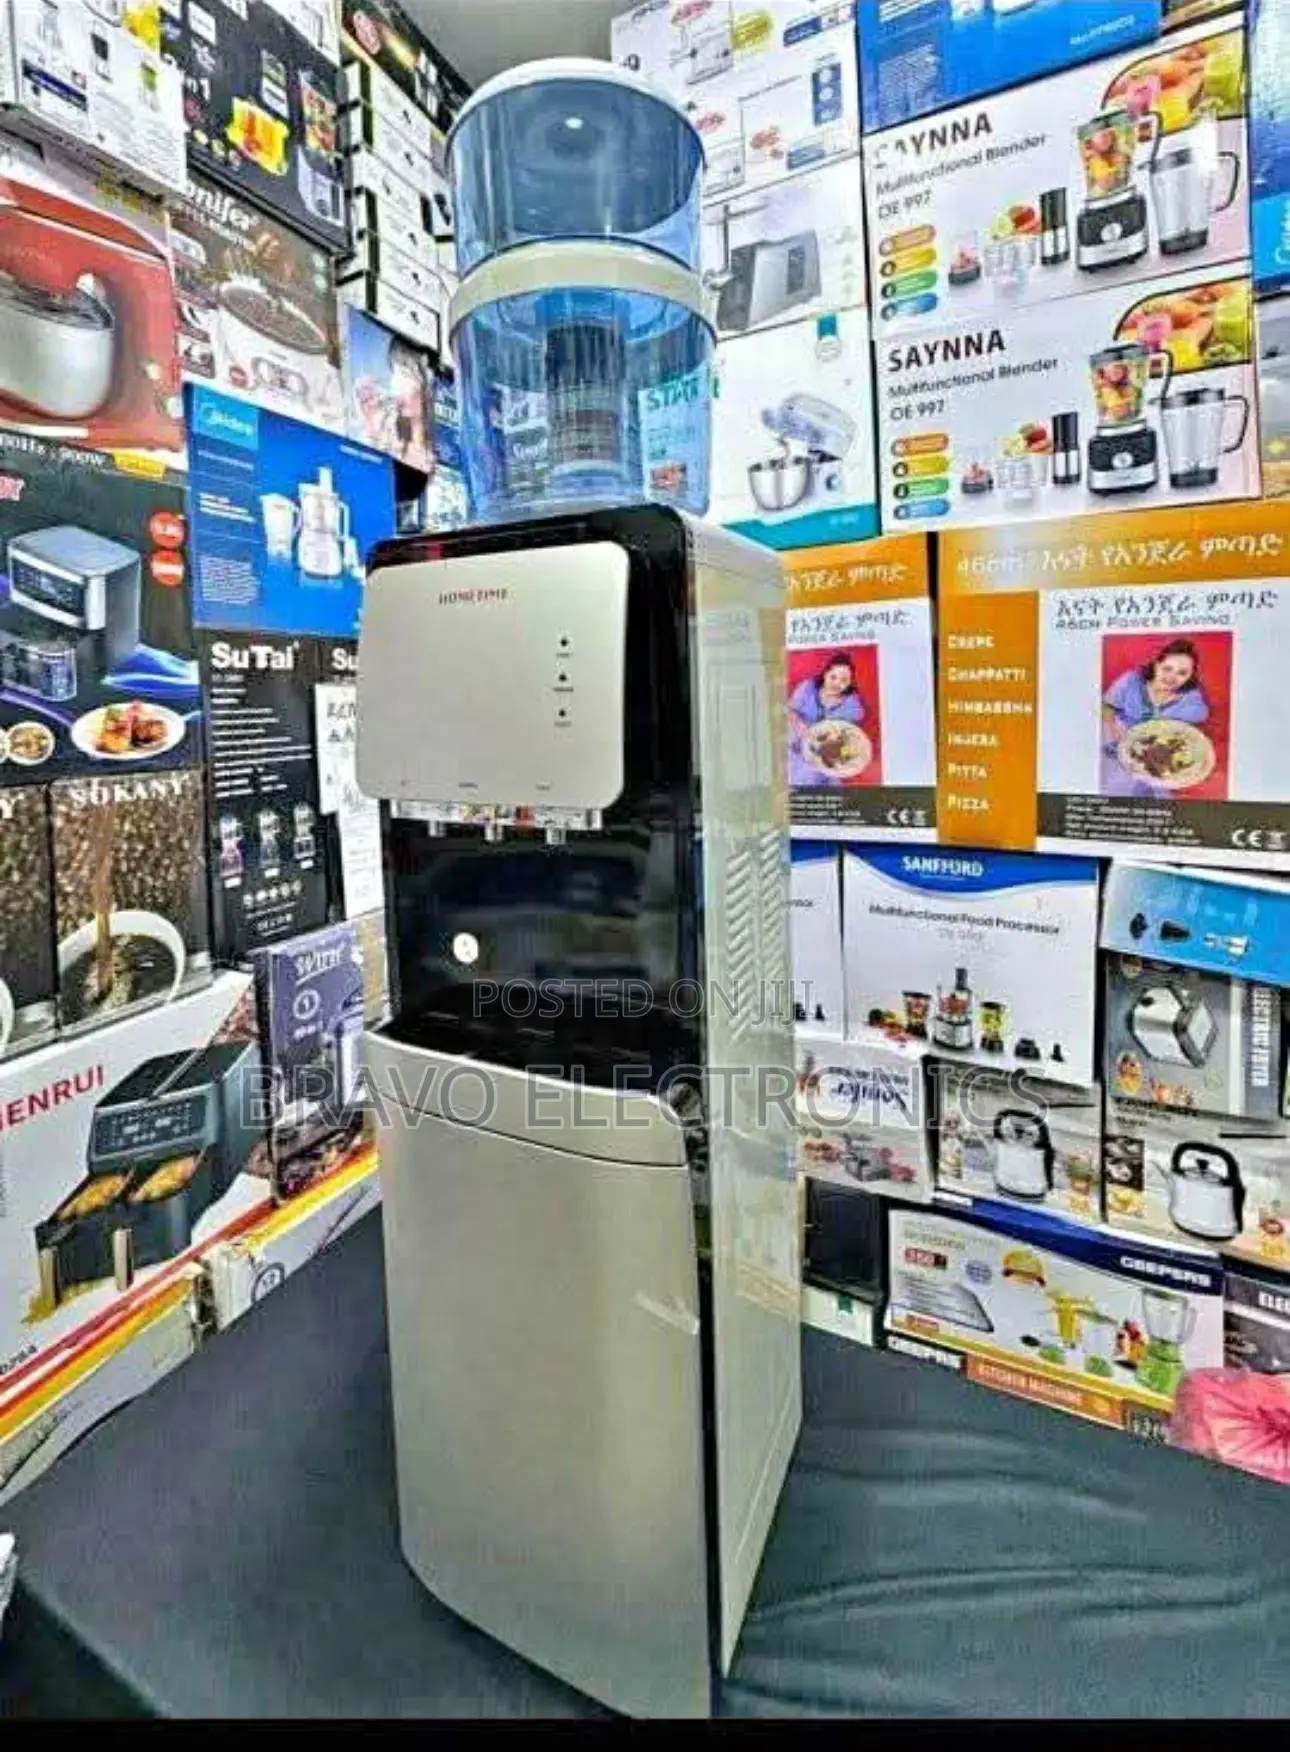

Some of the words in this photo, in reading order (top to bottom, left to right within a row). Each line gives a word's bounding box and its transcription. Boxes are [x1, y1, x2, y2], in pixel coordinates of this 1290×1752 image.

[888, 329, 1007, 373] SAYNNA
[889, 367, 995, 399] Multifunctional
[998, 357, 1059, 378] Blender
[917, 399, 945, 417] 997
[947, 793, 990, 810] PIZZA
[868, 903, 961, 926] Multifunctional
[963, 912, 994, 927] Food
[995, 917, 1060, 935] Processor
[0, 1064, 104, 1132] ENRUI
